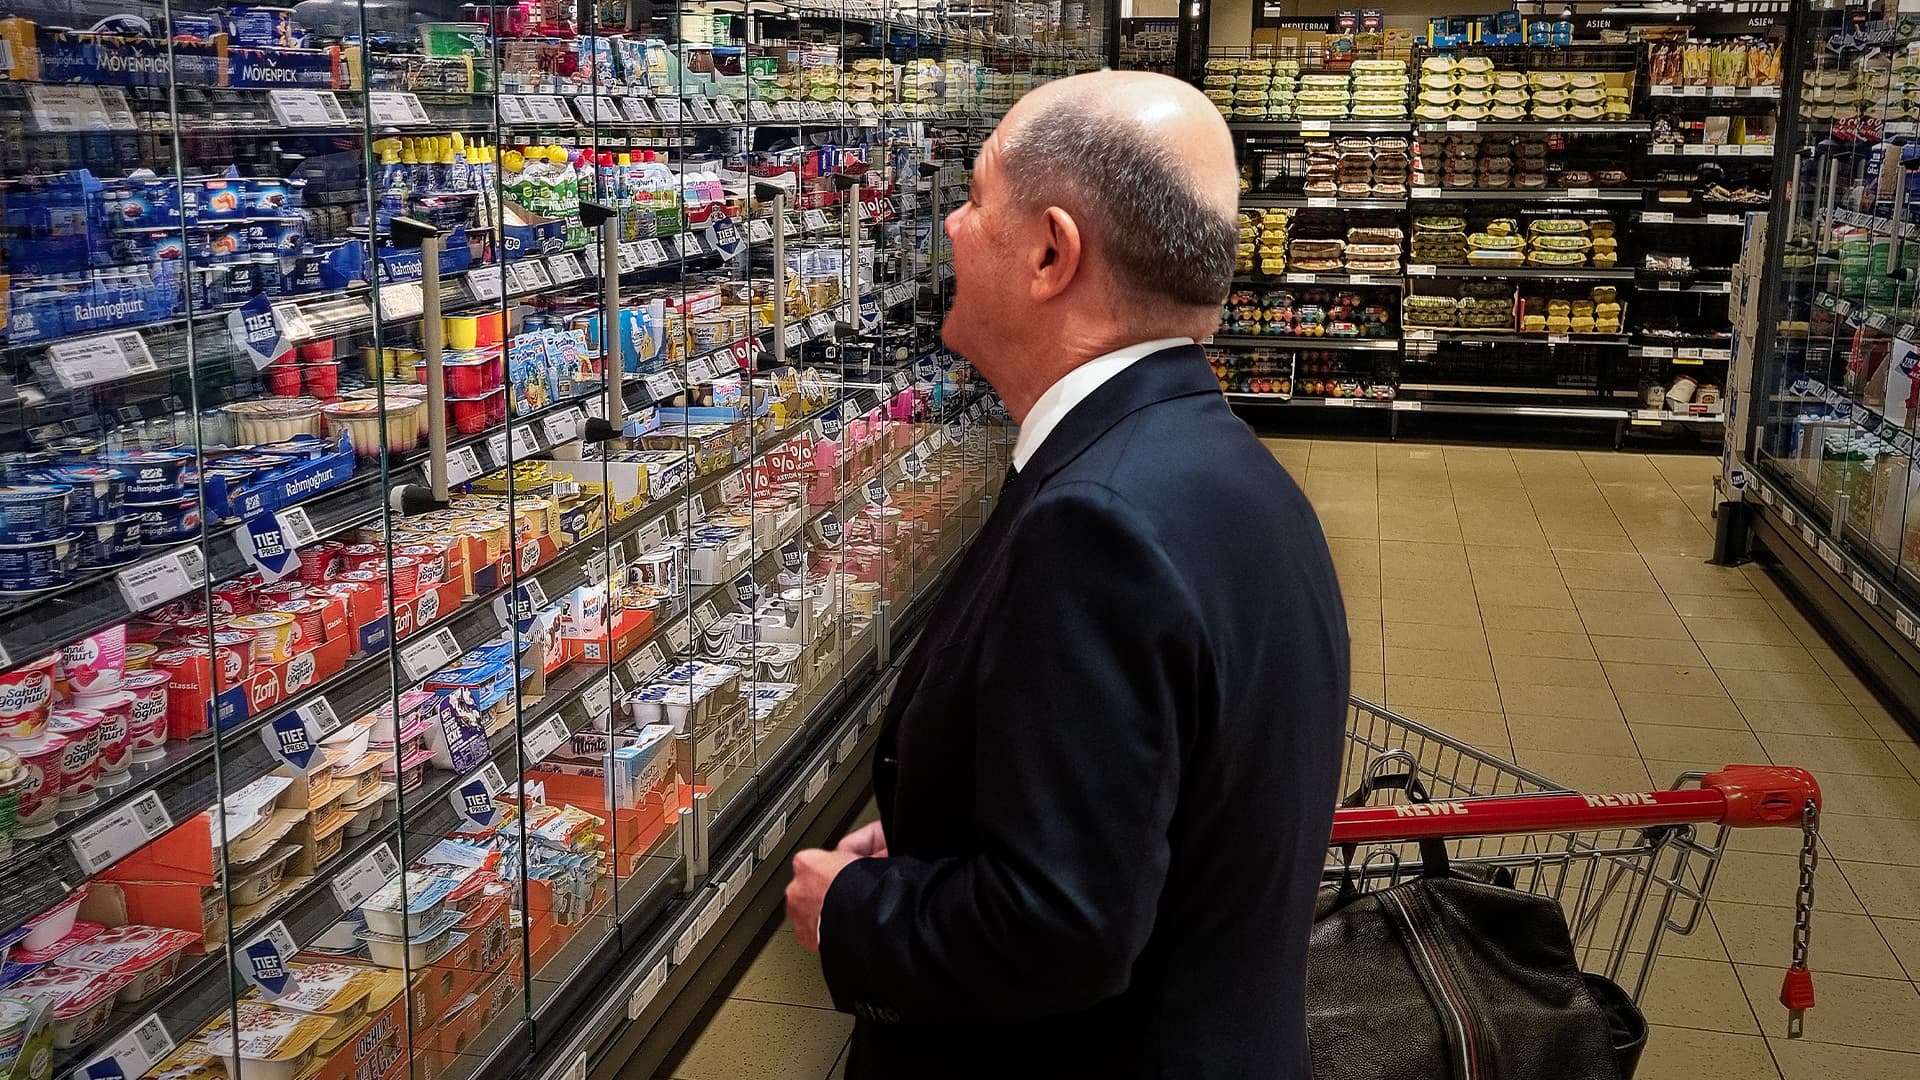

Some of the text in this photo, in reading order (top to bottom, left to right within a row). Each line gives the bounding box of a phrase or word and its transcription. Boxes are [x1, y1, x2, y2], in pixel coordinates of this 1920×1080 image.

[1281, 22, 1330, 31] MEDITERRAN
[1586, 20, 1610, 28] ASIEN
[1748, 17, 1773, 26] ASIEN
[96, 51, 170, 73] MÖVENPICK
[243, 64, 298, 82] MÖVENPICK
[716, 228, 734, 239] TIEF
[74, 300, 144, 321] Rahmjoghurt
[246, 313, 274, 332] TIEF
[823, 420, 839, 429] TIEF
[772, 455, 795, 472] %
[286, 467, 335, 498] Rahmjoghurt
[127, 483, 174, 494] Rahmjoghurt
[753, 489, 771, 498] KTION
[138, 525, 177, 536] mjoghurt
[822, 523, 838, 532] TIEF
[253, 531, 280, 547] TIEF
[260, 546, 283, 557] PREIS
[784, 551, 799, 561] TIEF
[507, 601, 529, 612] TEF
[6, 685, 43, 698] Sahne
[169, 682, 199, 690] Classic
[278, 728, 305, 744] TIEF
[285, 744, 307, 753] PREIS
[465, 794, 488, 806] TIEF
[1583, 792, 1658, 808] REWE
[1393, 801, 1469, 817] REWE
[252, 955, 279, 969] TIEF
[259, 968, 282, 978] PREIS
[354, 1011, 394, 1065] JOGHURT
